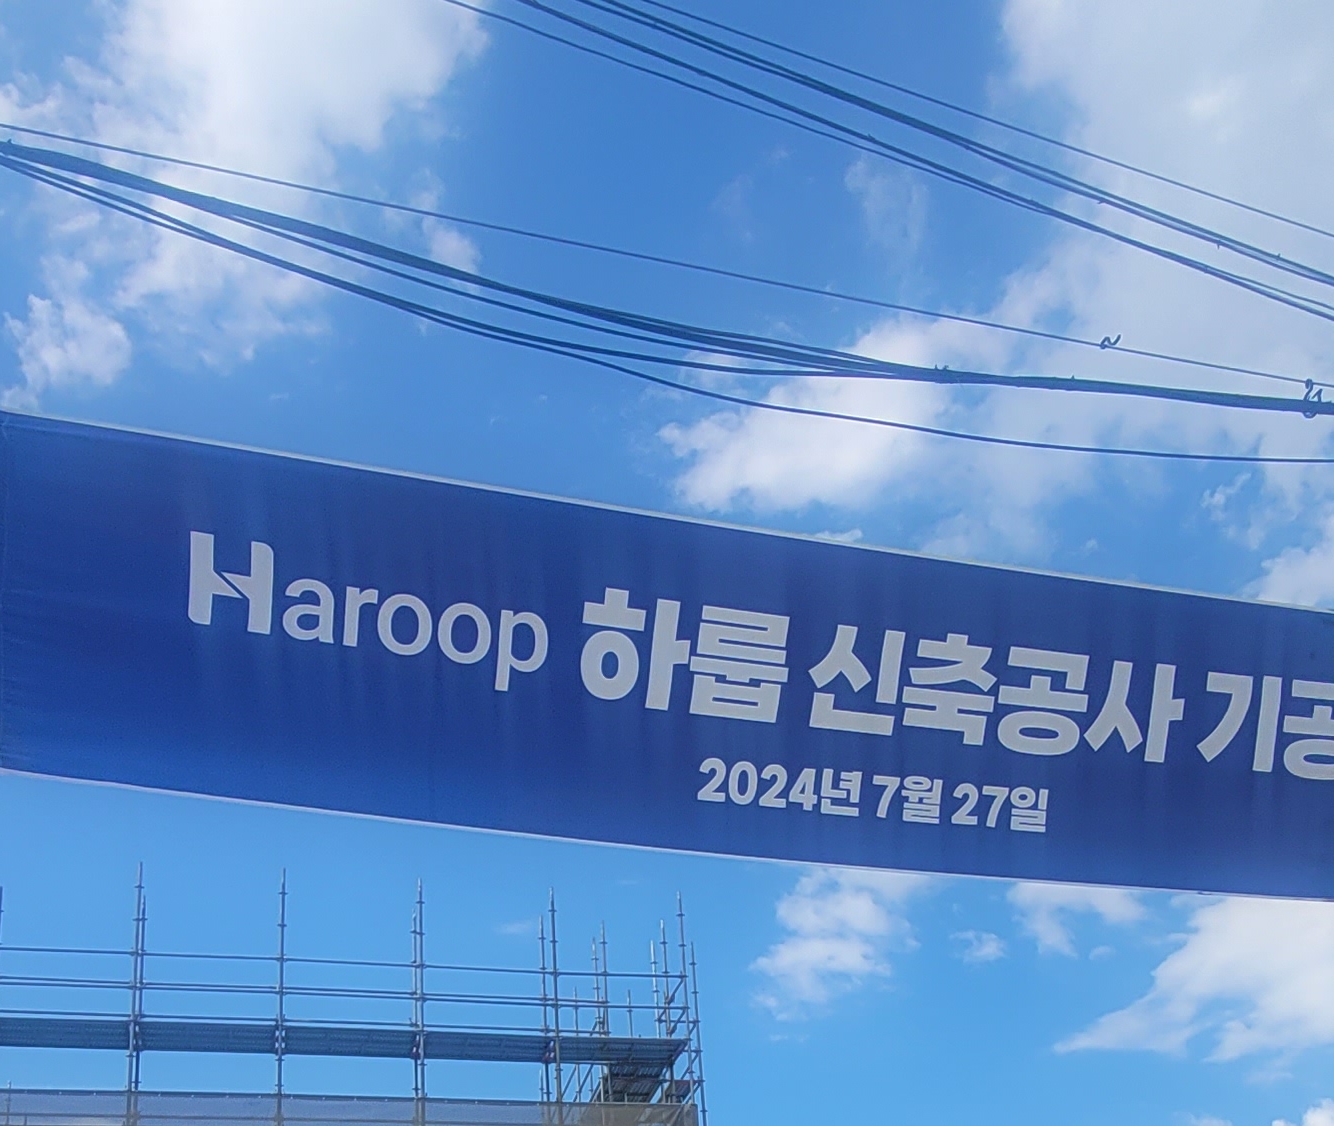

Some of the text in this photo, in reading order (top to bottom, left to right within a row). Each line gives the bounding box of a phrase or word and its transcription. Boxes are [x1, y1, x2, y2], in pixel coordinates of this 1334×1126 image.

[188, 531, 548, 692] Haroop
[580, 587, 790, 723] 하룹
[808, 624, 1185, 763] 신축공사
[697, 757, 1049, 833] 2024년 7월 27일
